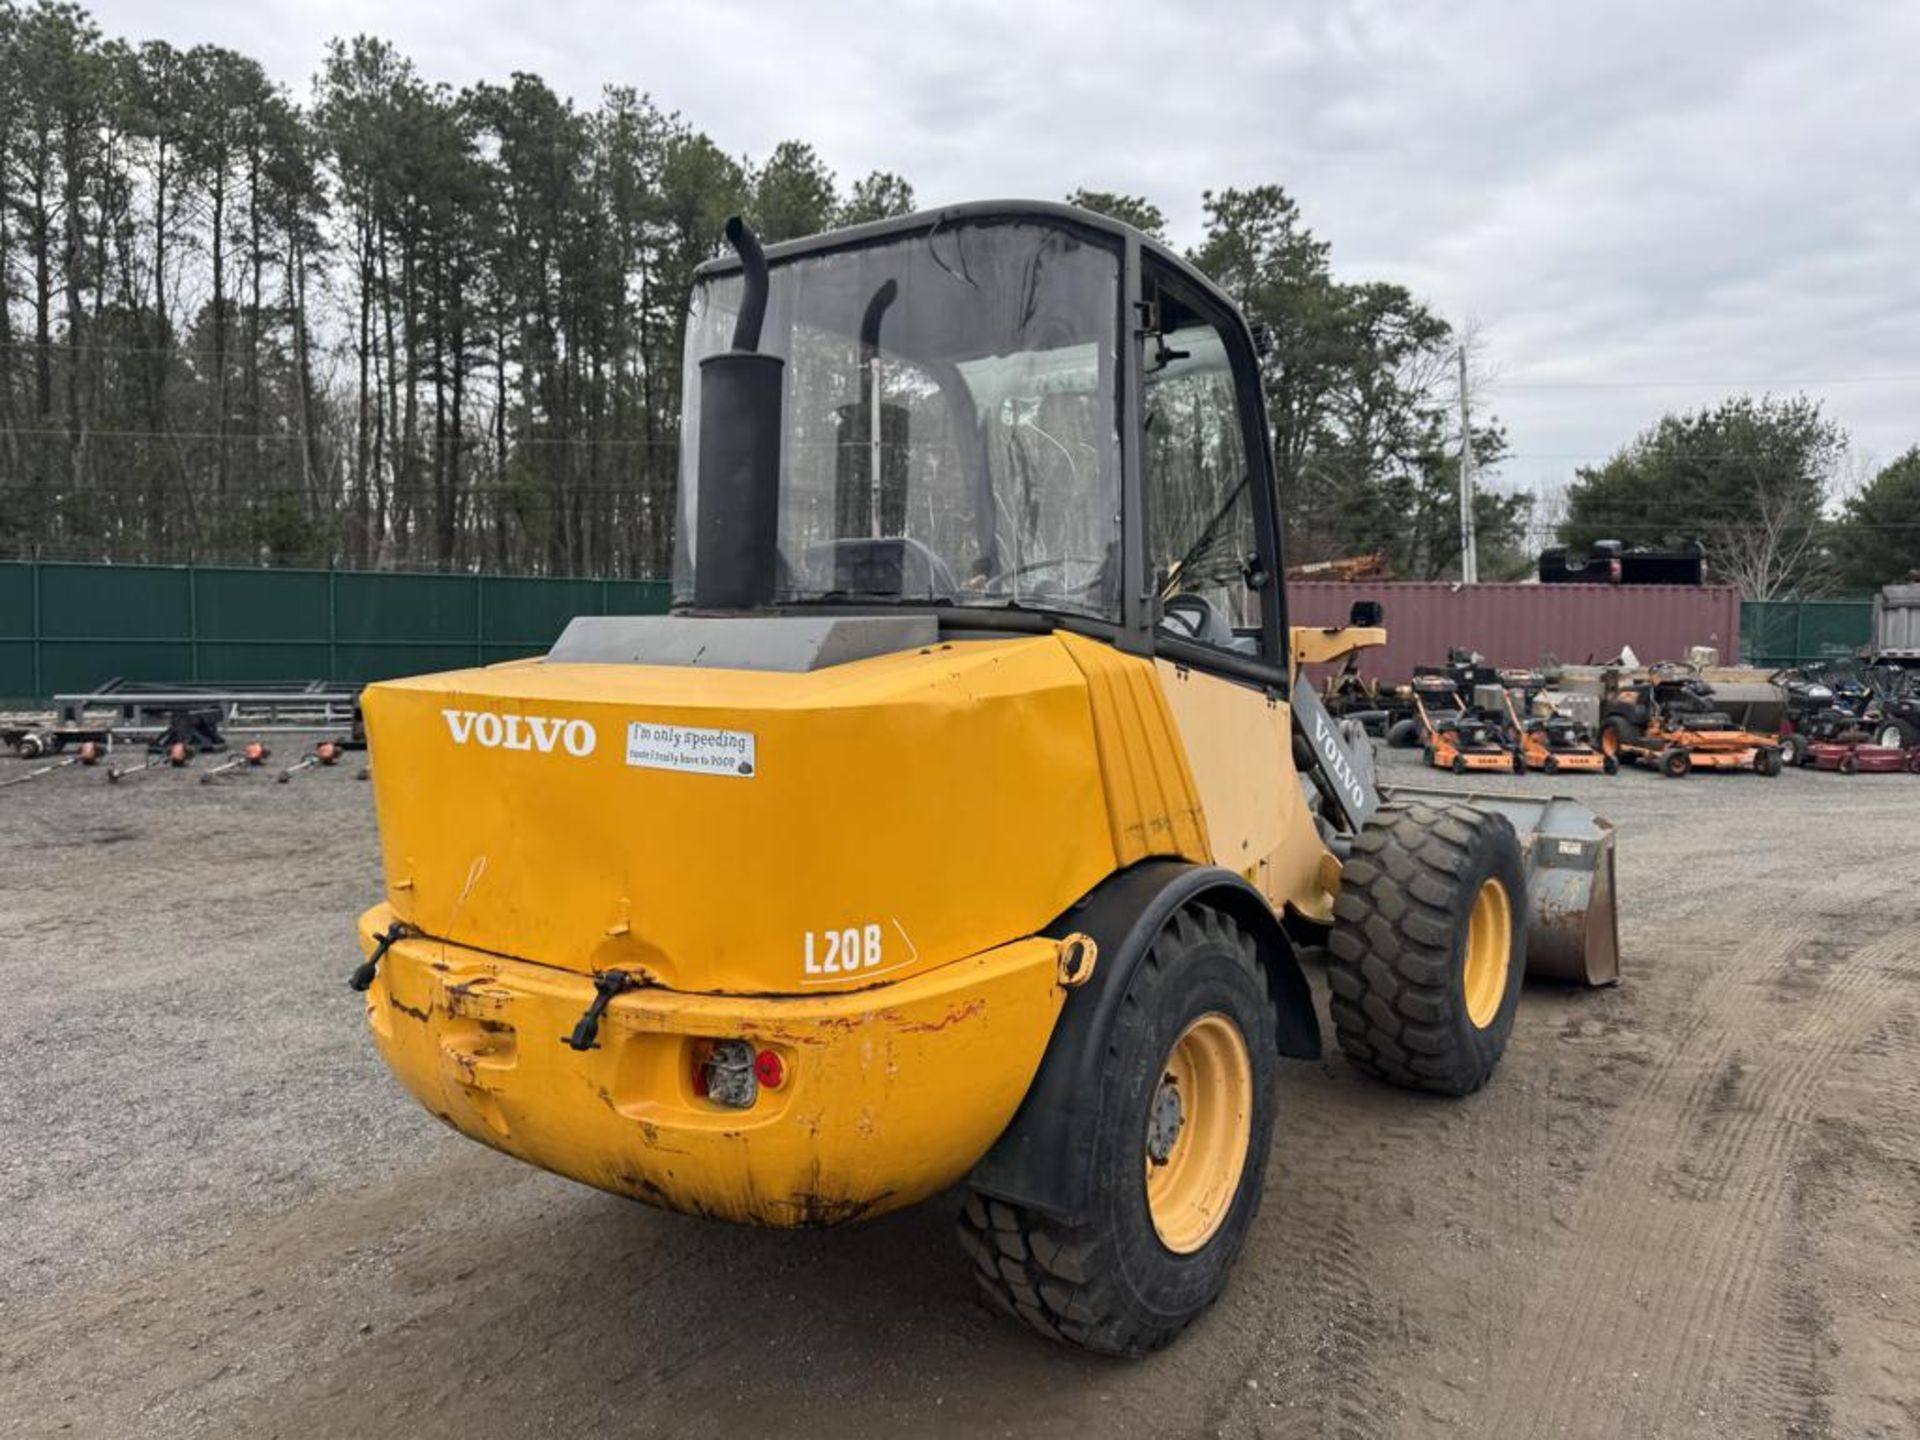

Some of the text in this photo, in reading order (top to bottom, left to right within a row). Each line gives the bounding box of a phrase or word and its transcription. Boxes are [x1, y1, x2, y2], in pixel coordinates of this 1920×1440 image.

[441, 709, 597, 757] VOLVO
[633, 723, 746, 754] I'm only speeding
[711, 755, 736, 768] POOP
[1315, 710, 1363, 808] VOLVO
[804, 923, 882, 974] L20B
